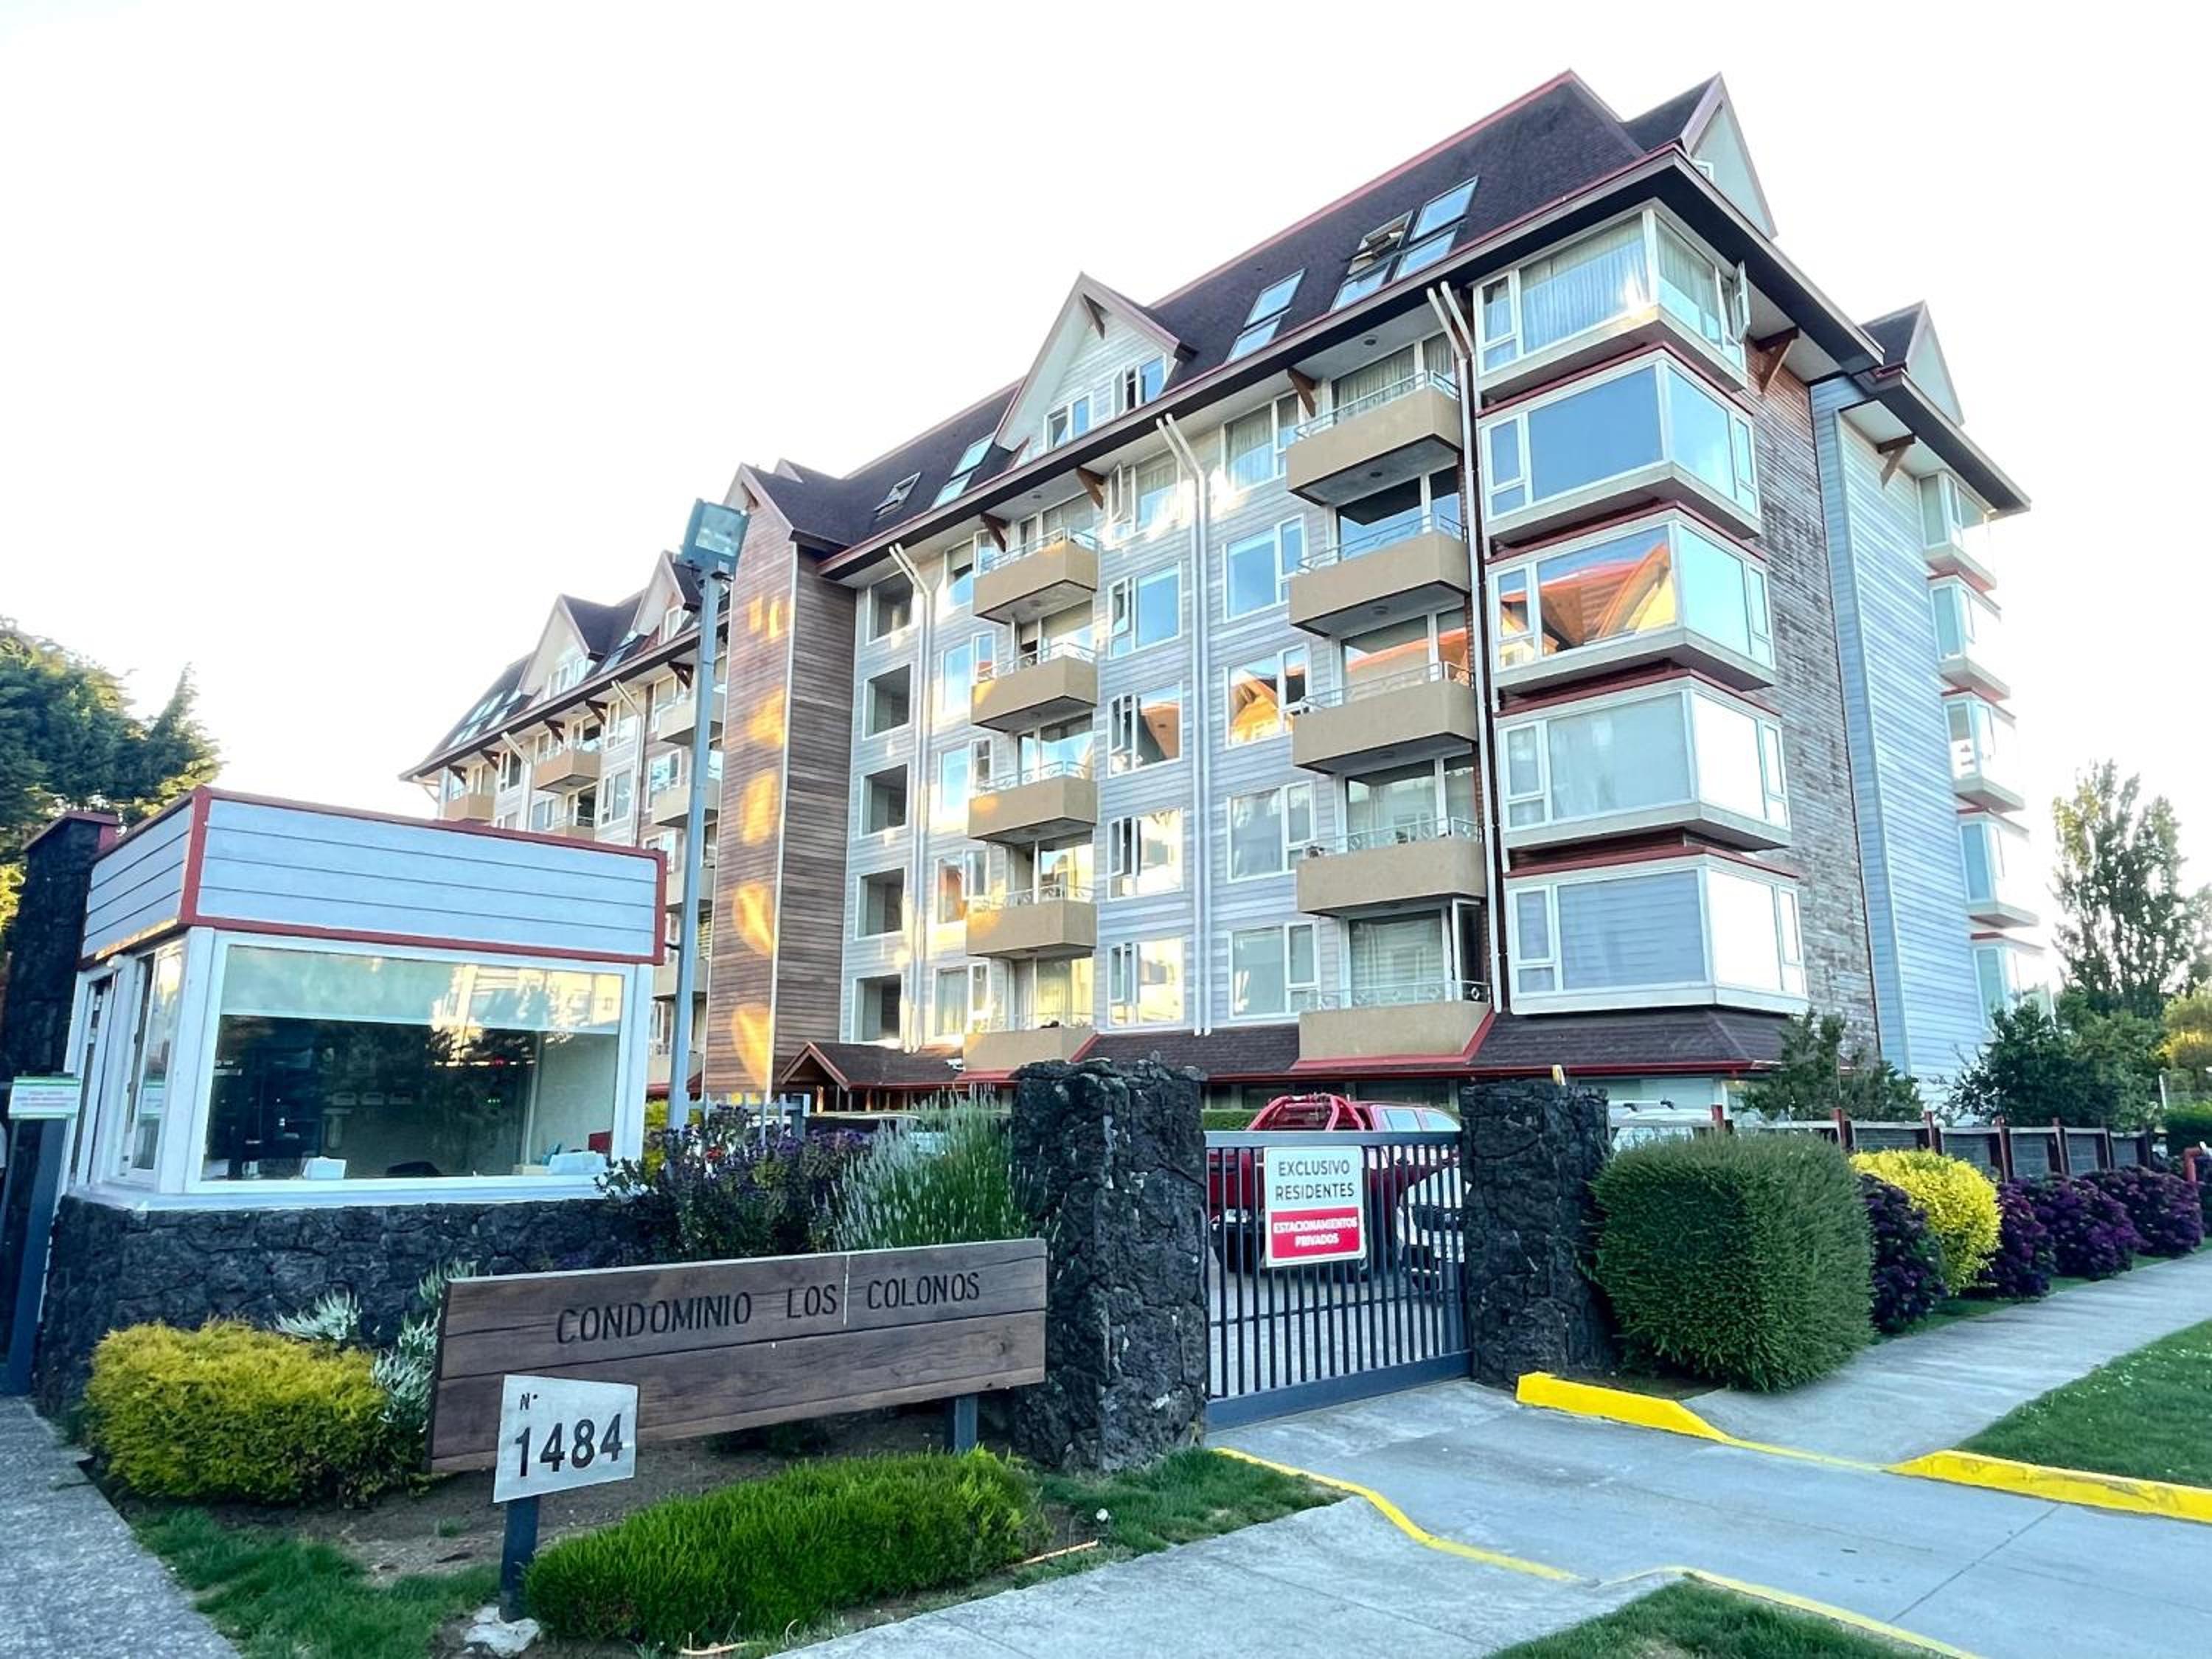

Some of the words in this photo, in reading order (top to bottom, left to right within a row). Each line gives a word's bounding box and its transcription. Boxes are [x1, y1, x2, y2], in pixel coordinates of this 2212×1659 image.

[1278, 1159, 1350, 1177] EXCLUSIVO
[1275, 1183, 1354, 1200] RESIDENTES
[1273, 1217, 1357, 1234] ESTACIONAMIENTOS
[1295, 1233, 1339, 1248] PRIVADOS
[557, 1291, 751, 1344] CONDOMINIO
[786, 1284, 838, 1318] LOS
[867, 1271, 980, 1310] COLONOS
[515, 1413, 623, 1478] 1484
